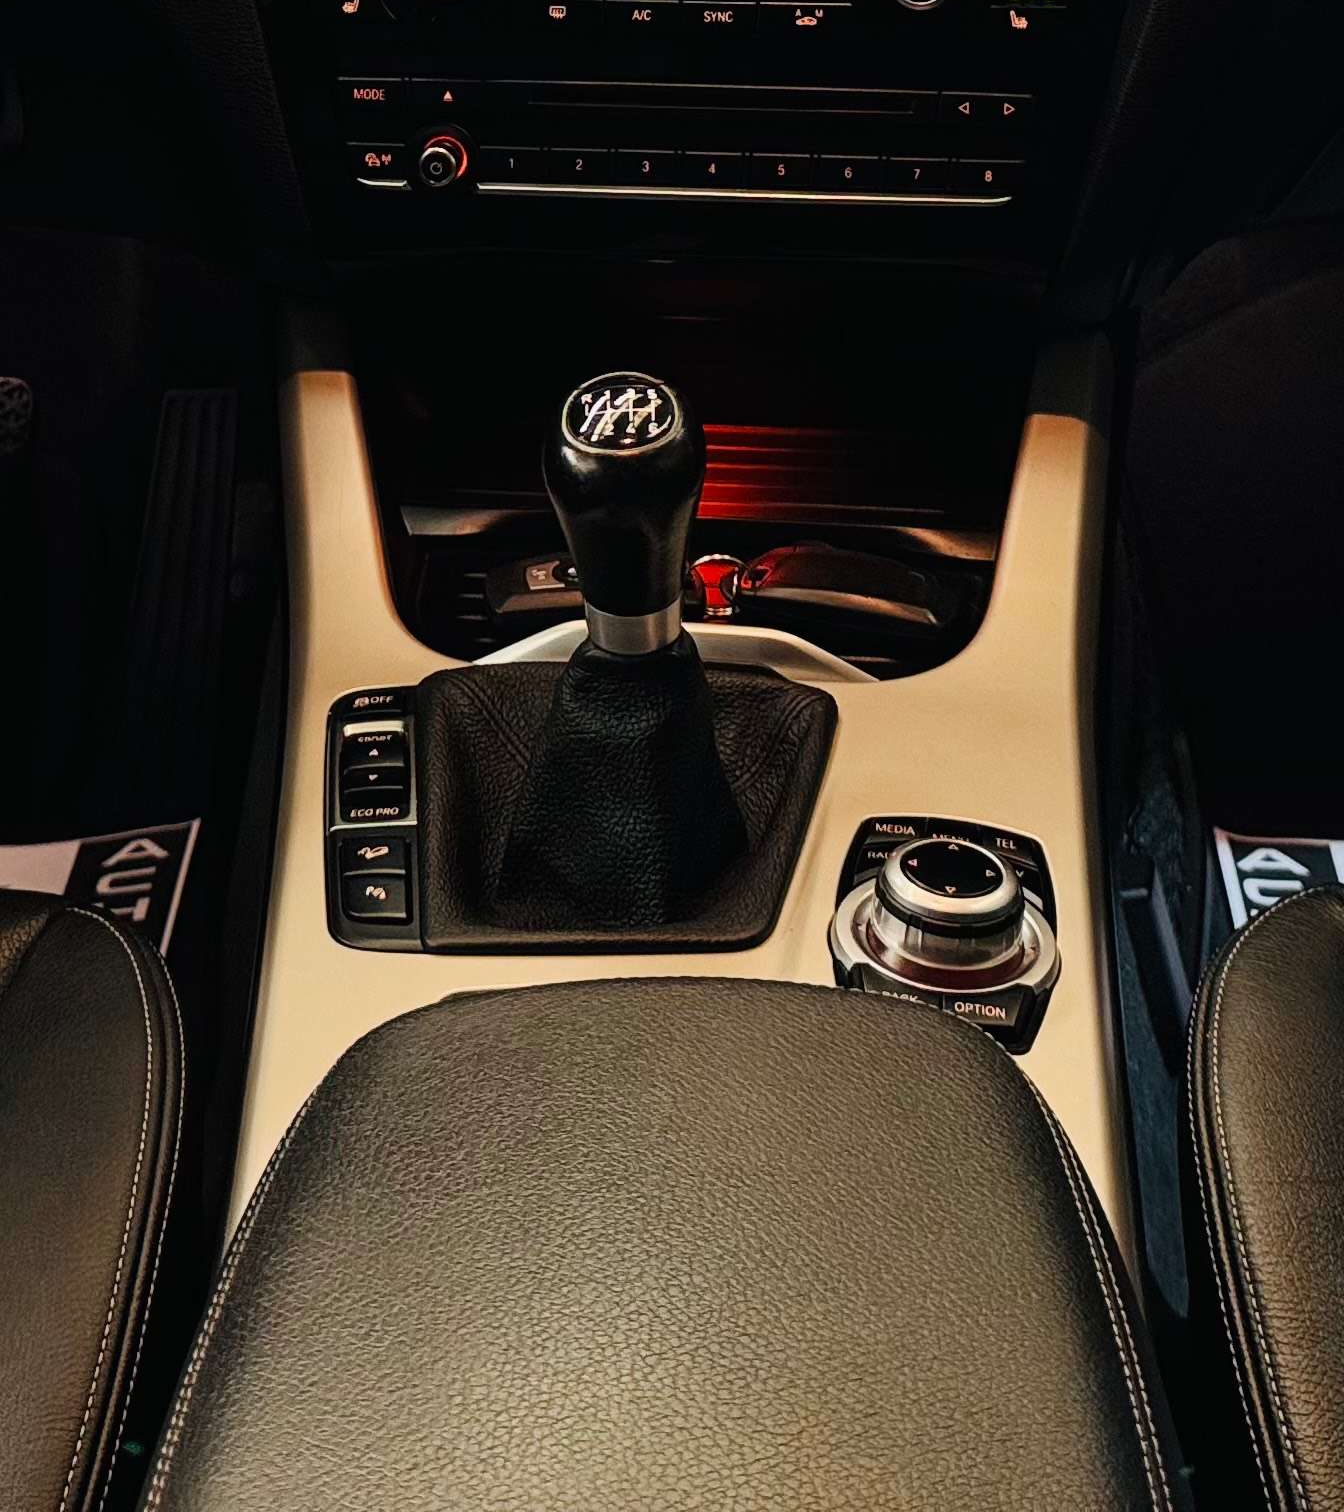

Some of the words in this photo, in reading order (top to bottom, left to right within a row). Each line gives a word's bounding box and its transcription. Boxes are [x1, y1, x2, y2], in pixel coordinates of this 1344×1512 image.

[632, 9, 652, 22] A/C
[703, 10, 734, 23] SYNC
[353, 88, 386, 101] MODE
[508, 158, 515, 168] 1
[575, 159, 583, 170] 2
[642, 160, 650, 172] 3
[708, 163, 716, 174] 4
[777, 164, 785, 176] 5
[844, 166, 852, 178] 6
[913, 168, 921, 180] 7
[984, 170, 993, 182] 8
[370, 695, 394, 704] OFF
[350, 808, 374, 818] ECO
[376, 806, 400, 816] PRO
[874, 823, 916, 836] MEDIA
[995, 837, 1017, 850] TEL
[954, 1001, 1007, 1019] OPTION
